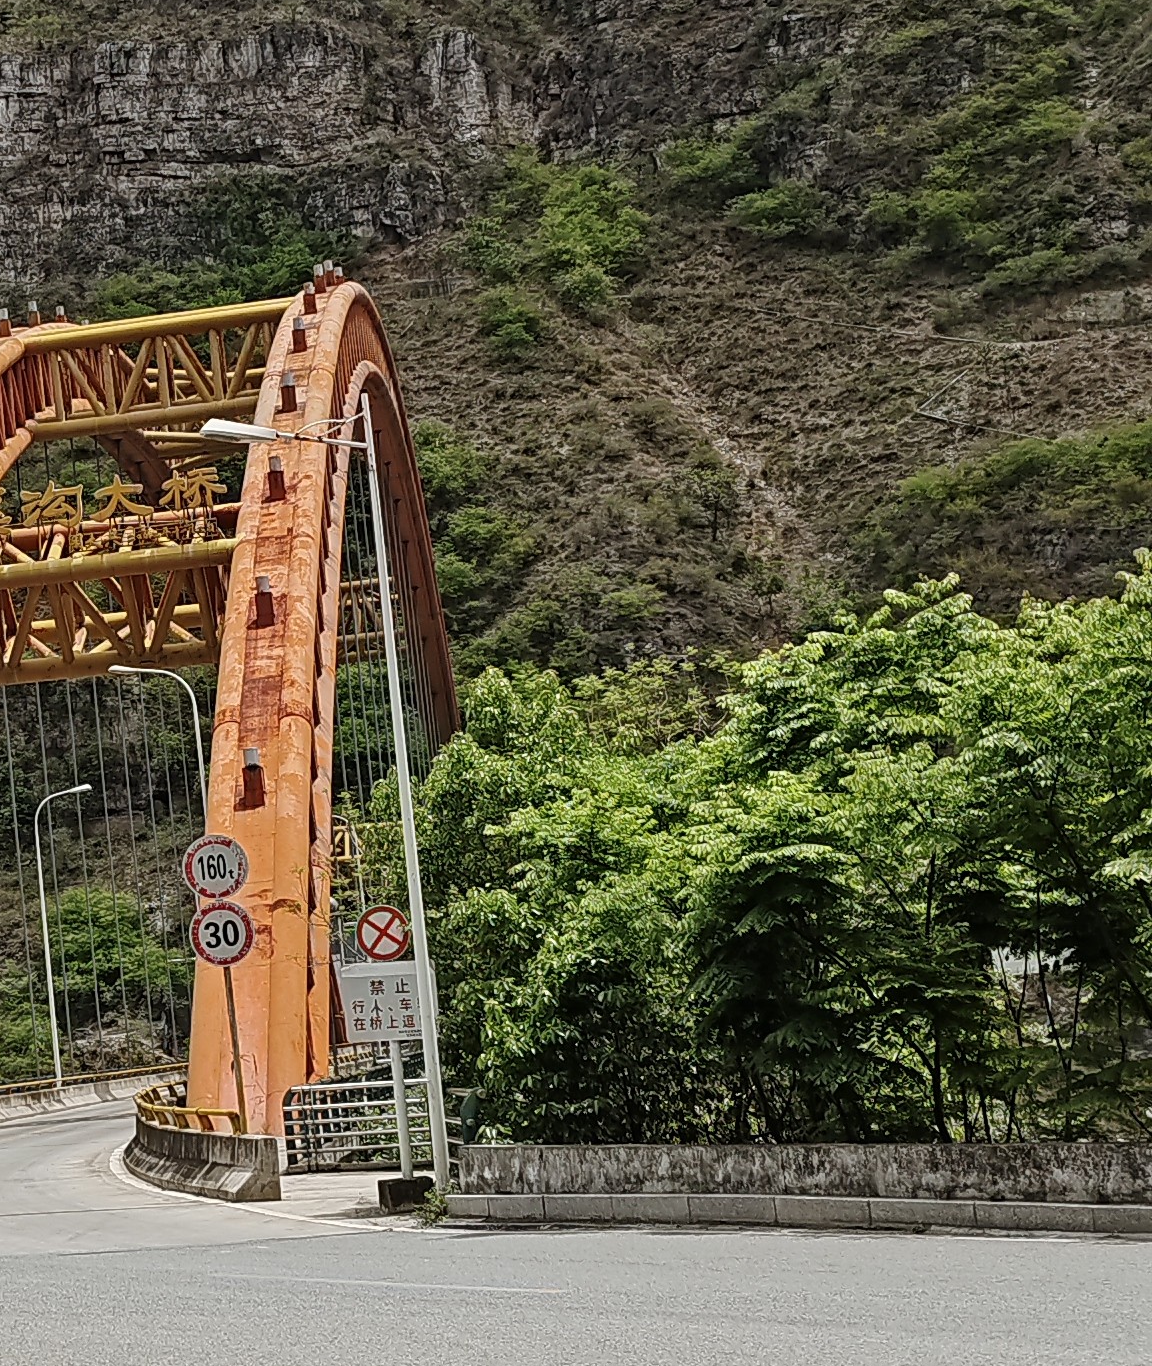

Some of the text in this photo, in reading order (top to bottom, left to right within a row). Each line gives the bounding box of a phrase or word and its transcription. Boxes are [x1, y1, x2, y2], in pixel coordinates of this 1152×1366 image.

[203, 919, 240, 949] 30
[369, 977, 411, 996] 禁止
[351, 997, 421, 1015] 行人、车
[353, 1014, 422, 1031] 在桥上逗
